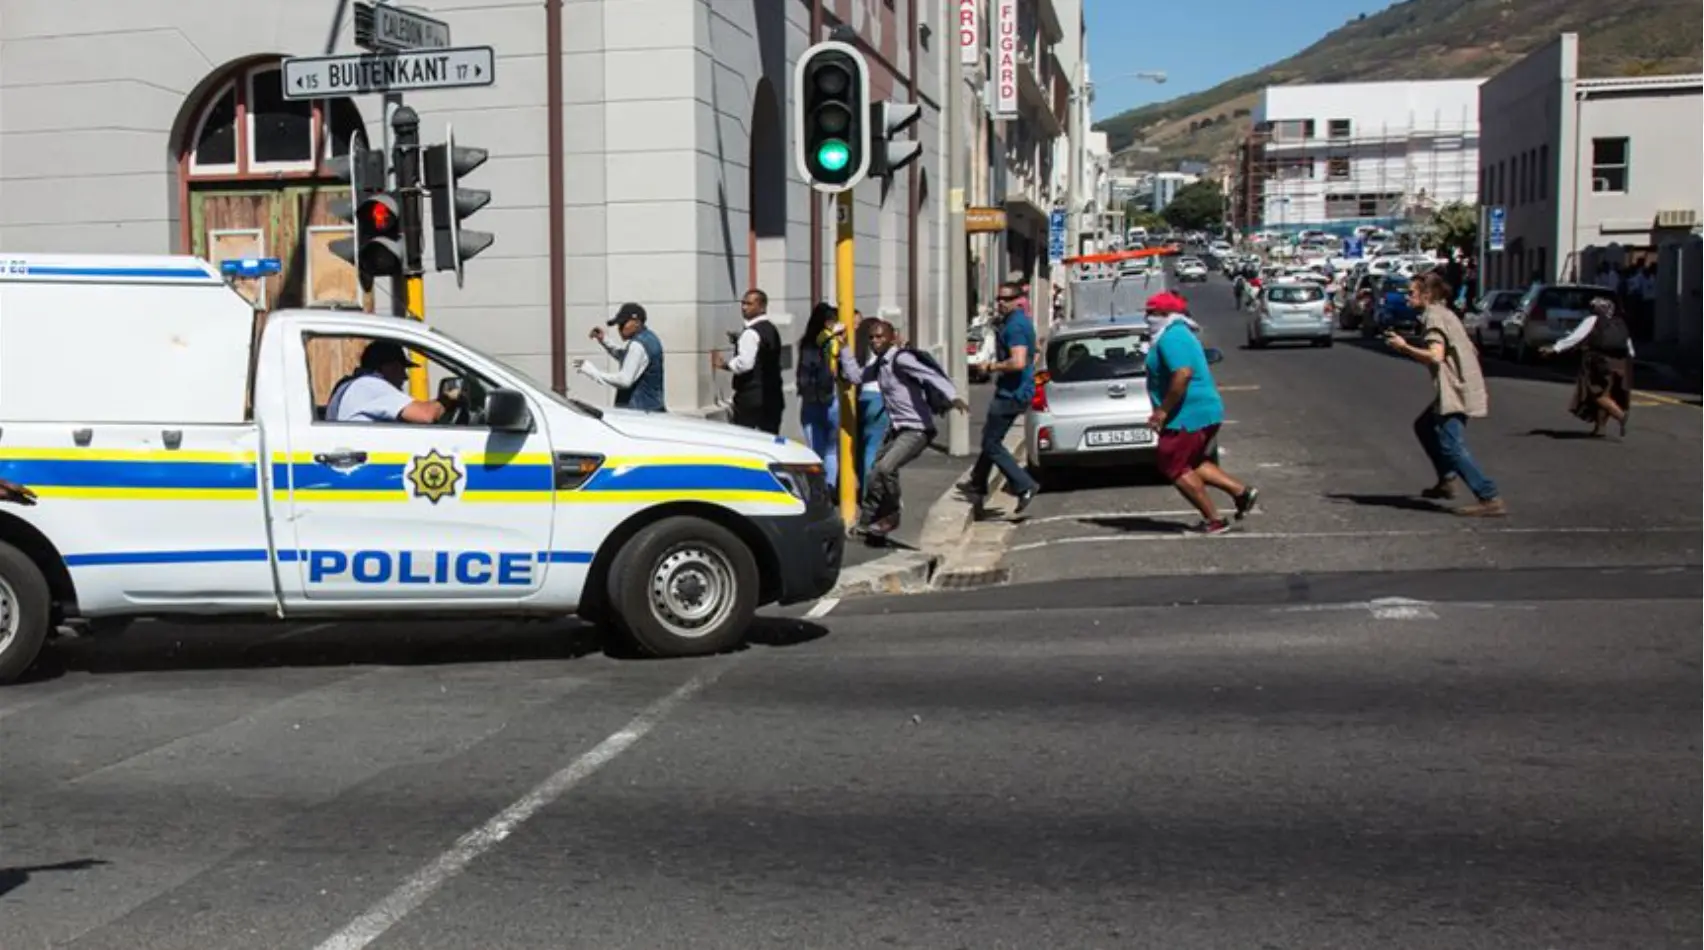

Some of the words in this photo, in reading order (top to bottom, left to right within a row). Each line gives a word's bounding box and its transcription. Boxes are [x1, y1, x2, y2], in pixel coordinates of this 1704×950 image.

[1001, 6, 1013, 99] FUGARD
[306, 74, 319, 89] 15
[328, 56, 449, 88] BUITENKANT
[455, 64, 468, 80] 17
[308, 550, 533, 585] POLICE
